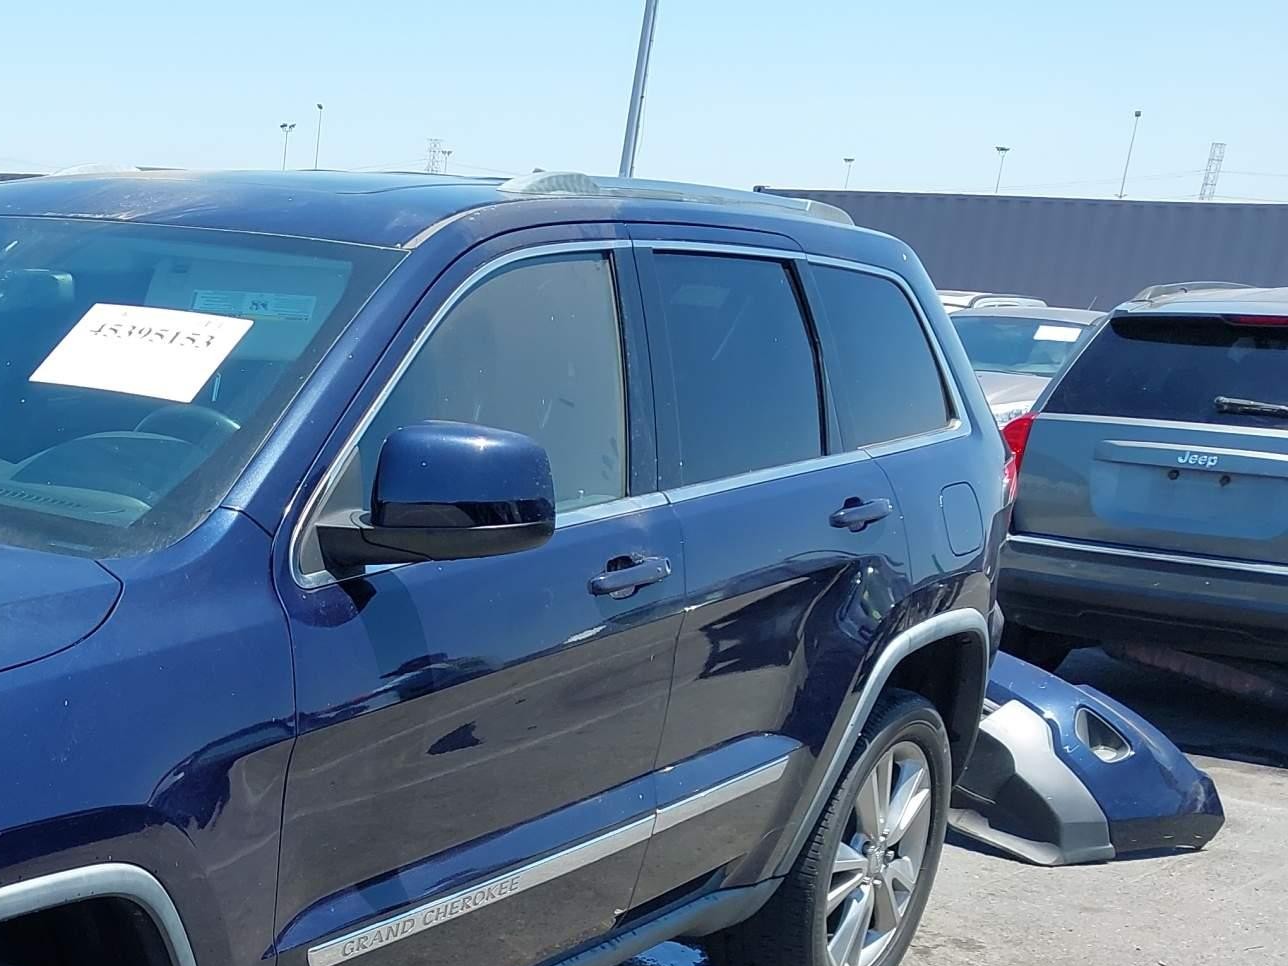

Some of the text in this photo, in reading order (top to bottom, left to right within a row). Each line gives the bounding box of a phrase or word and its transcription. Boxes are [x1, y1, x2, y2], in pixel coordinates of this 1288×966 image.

[1177, 451, 1218, 468] Jeep
[341, 875, 521, 957] GRAND CHEROKEE
